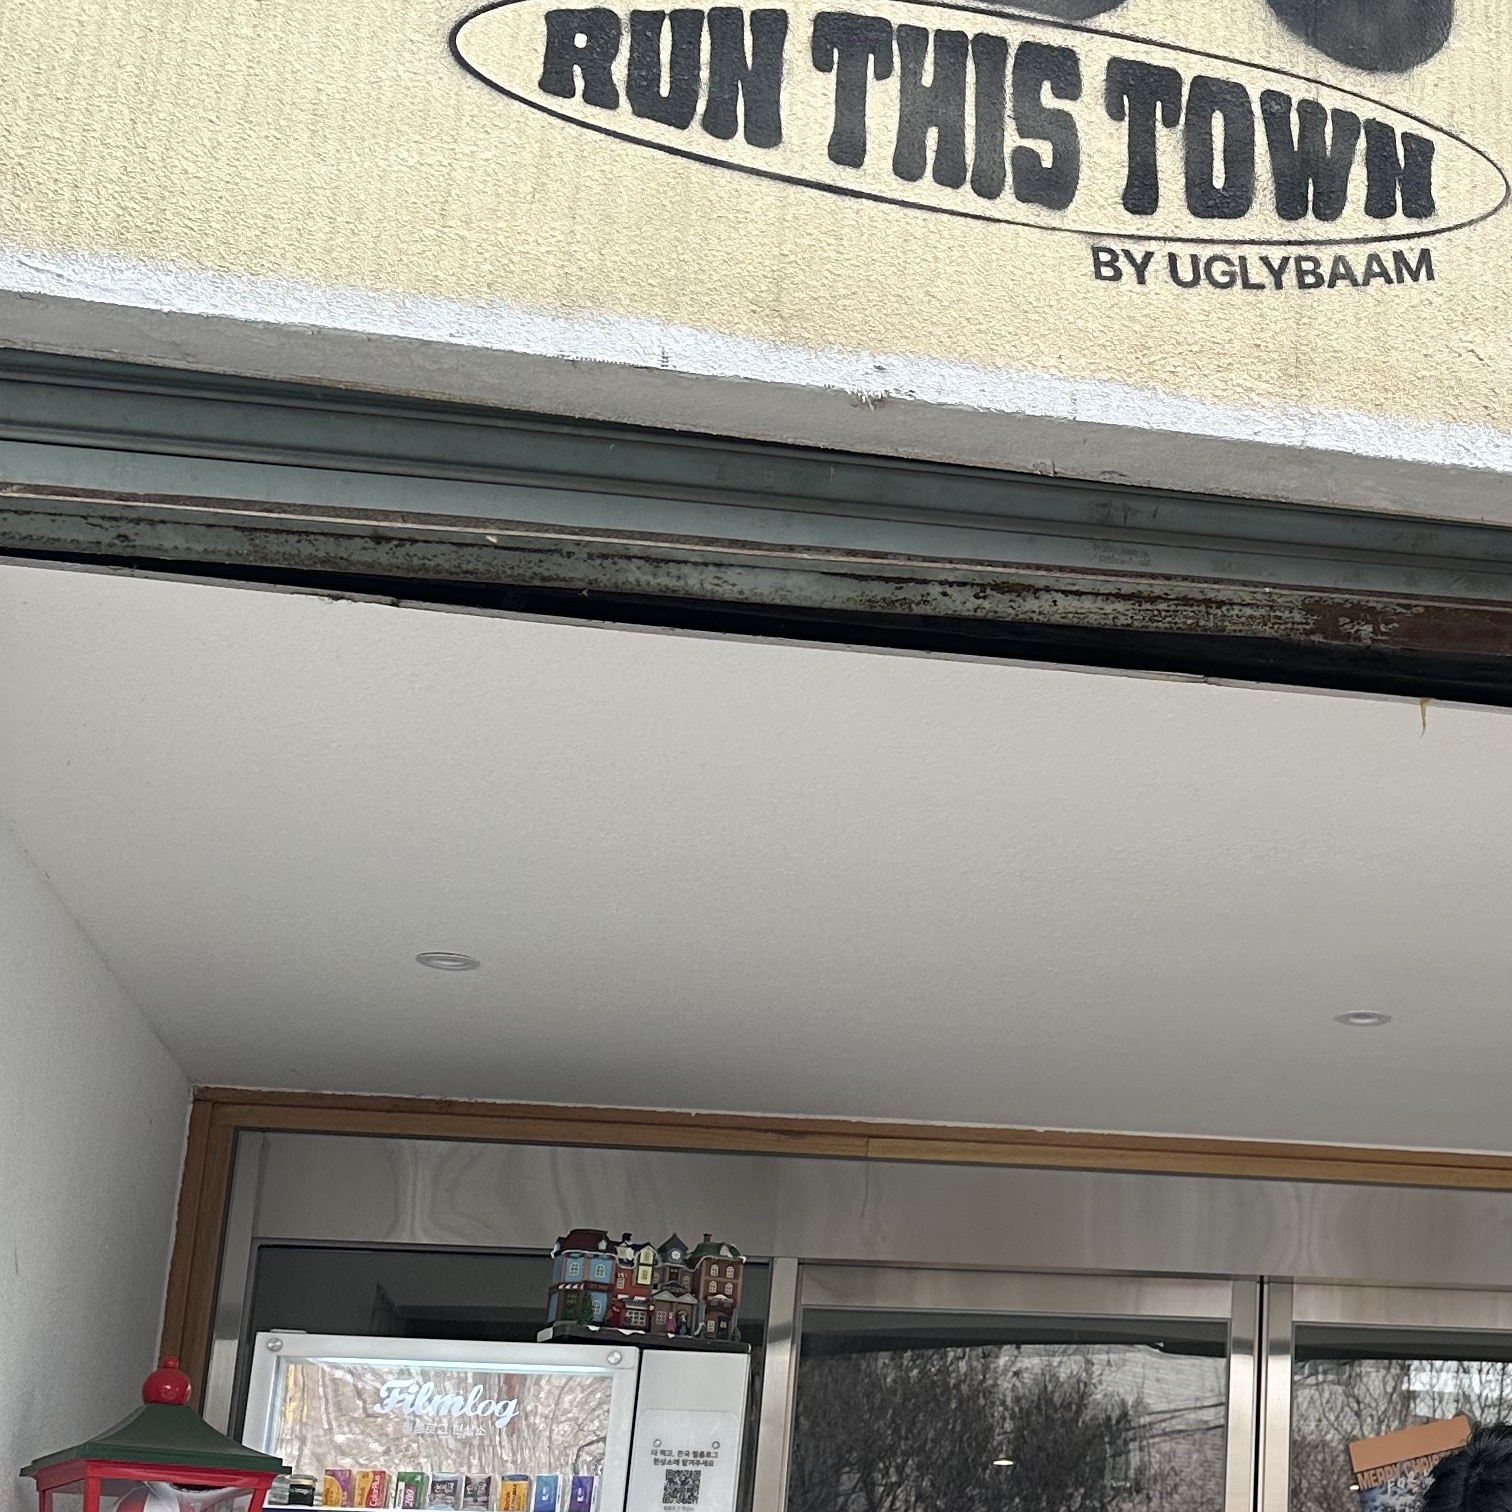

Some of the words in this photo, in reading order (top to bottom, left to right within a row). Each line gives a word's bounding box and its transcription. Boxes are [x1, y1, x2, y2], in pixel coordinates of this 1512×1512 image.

[538, 6, 790, 148] RUN
[810, 10, 1082, 211] THIS
[1104, 55, 1437, 222] TOWN
[1091, 246, 1153, 285] BY
[1167, 247, 1436, 291] UGLYBAAM
[373, 1379, 520, 1429] Filmlog
